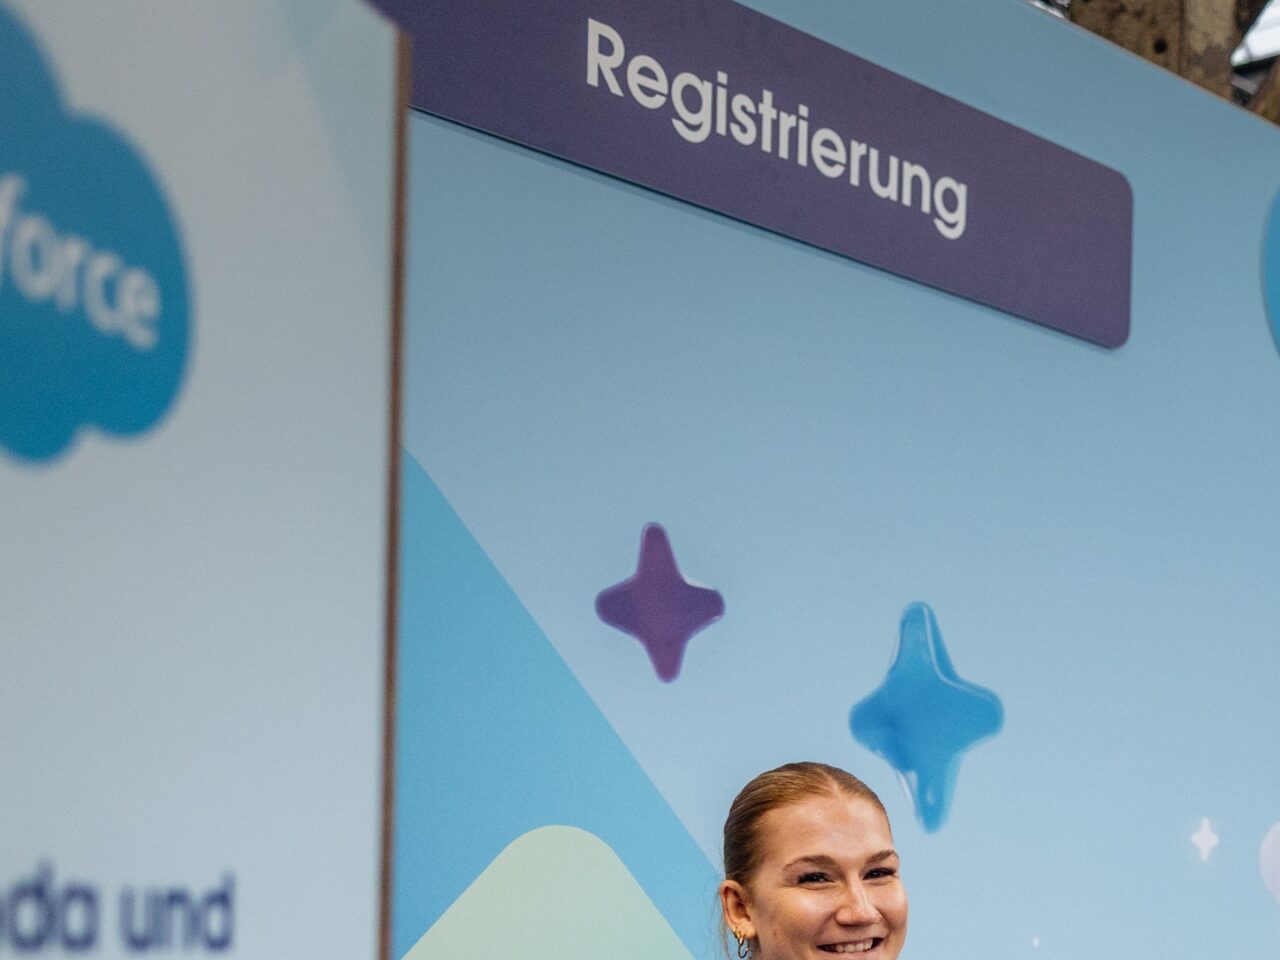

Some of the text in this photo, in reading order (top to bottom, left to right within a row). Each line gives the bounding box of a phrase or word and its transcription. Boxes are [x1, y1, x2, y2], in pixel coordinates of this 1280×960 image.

[586, 17, 969, 240] Registrierung
[0, 858, 237, 954] da und
